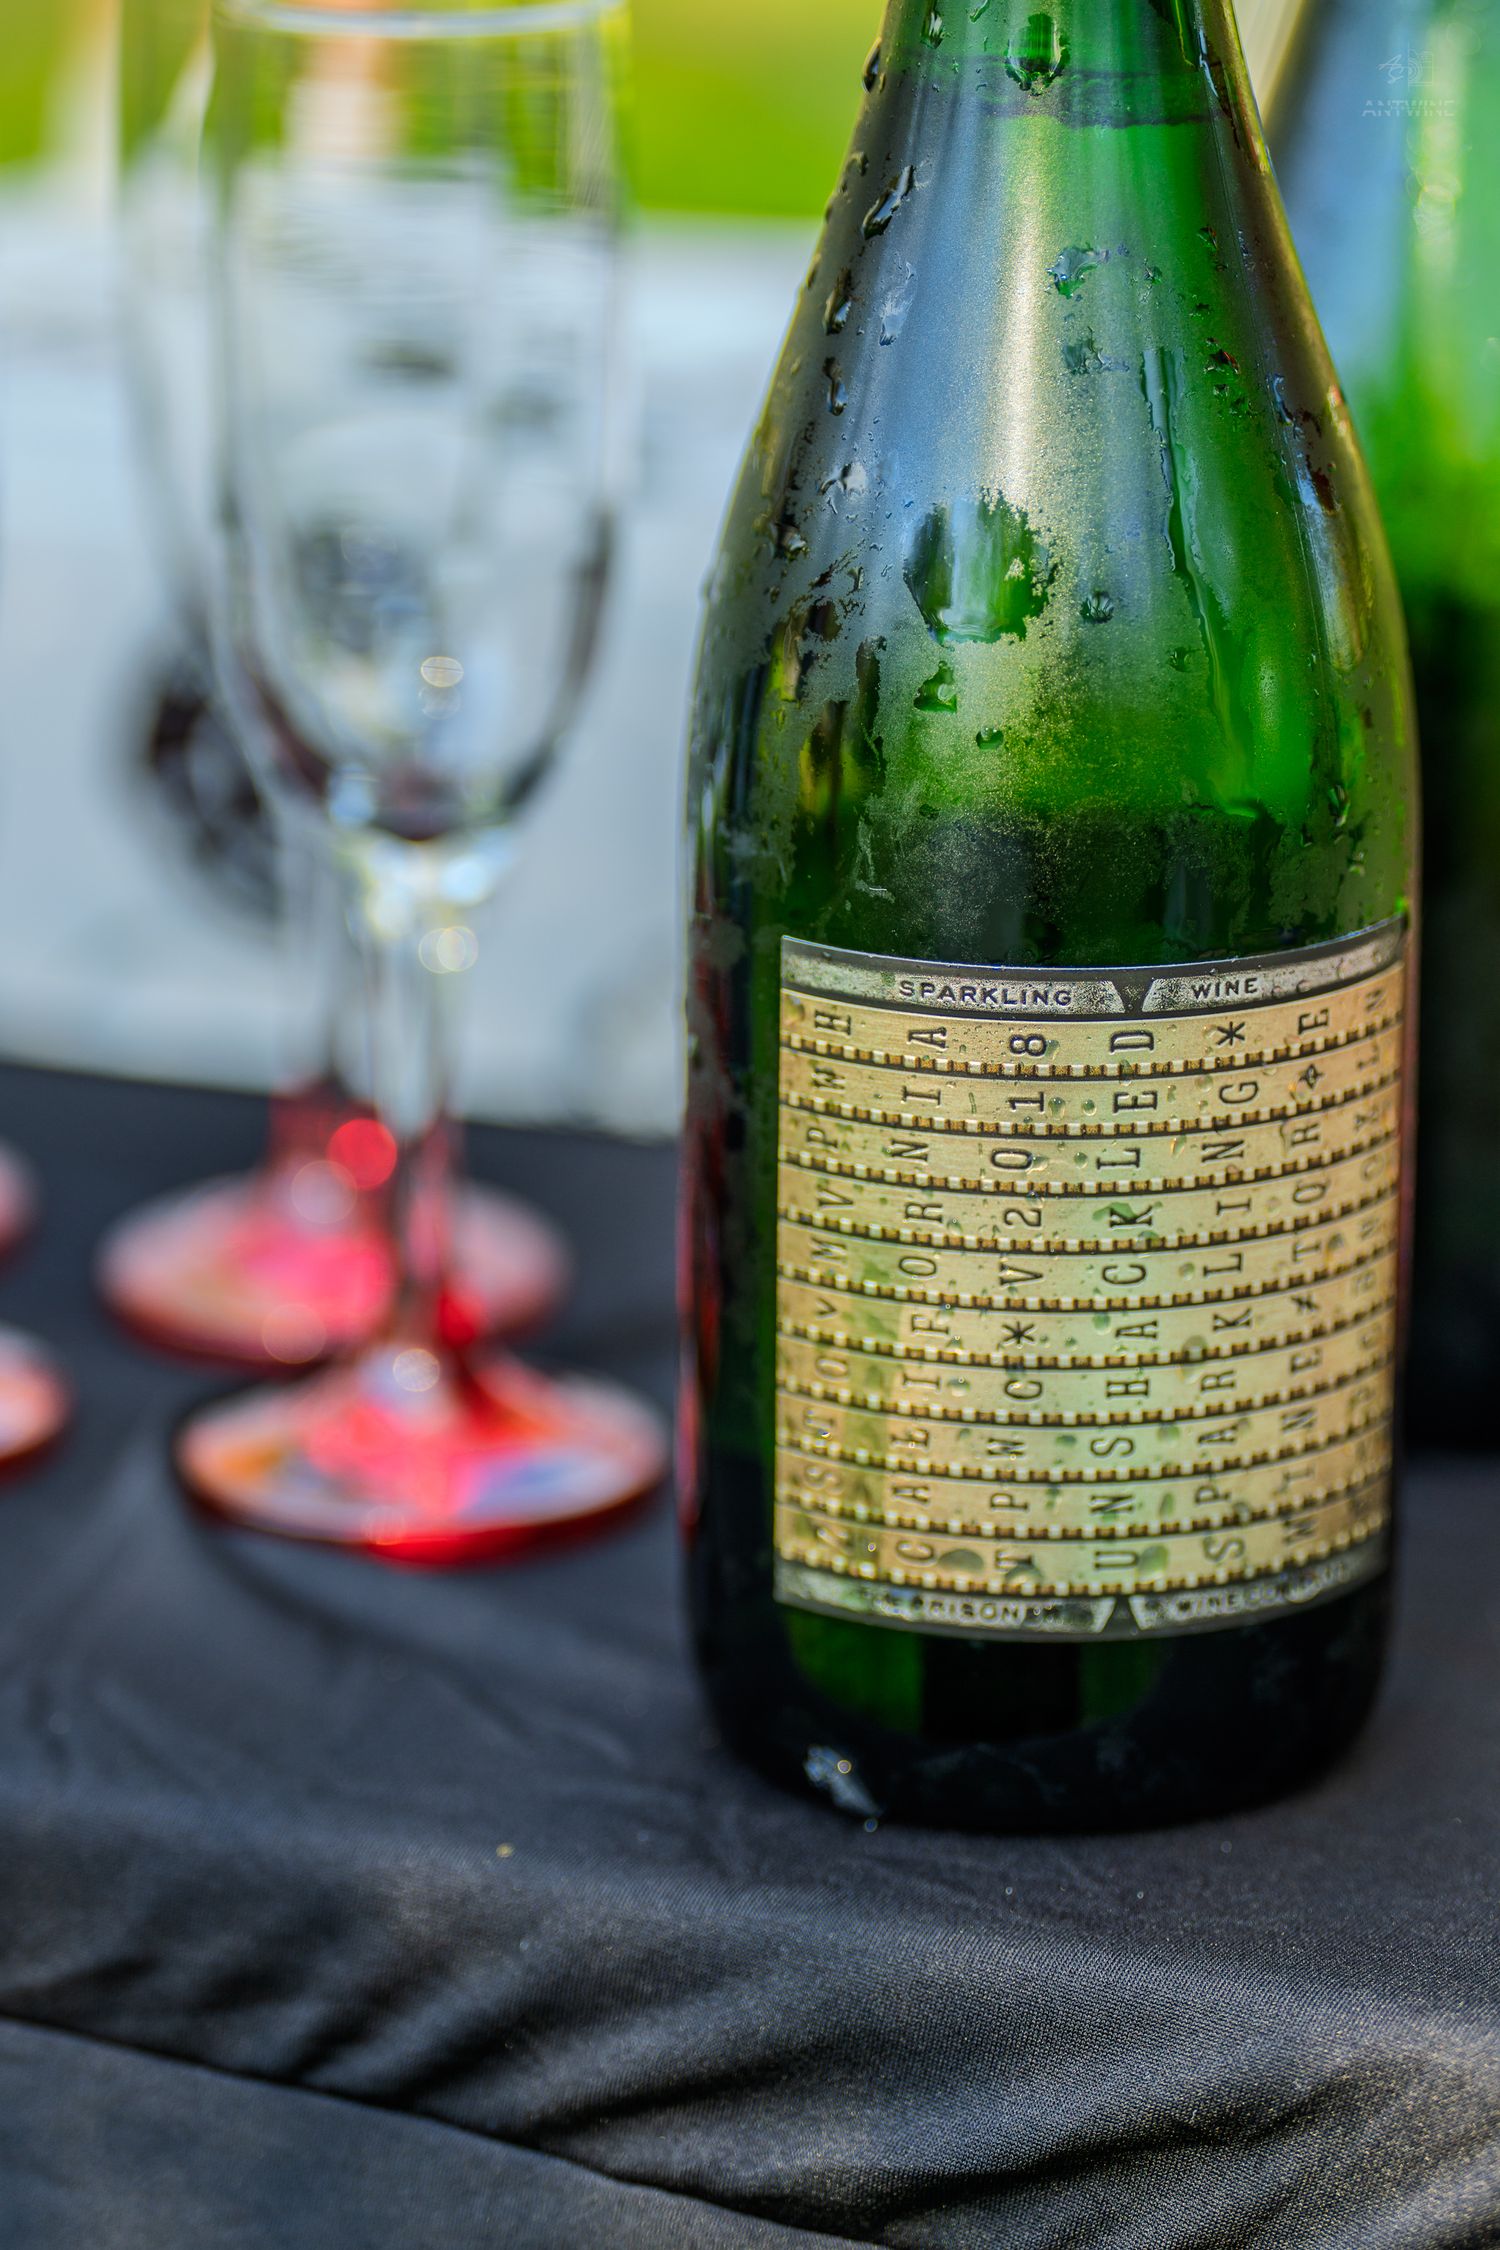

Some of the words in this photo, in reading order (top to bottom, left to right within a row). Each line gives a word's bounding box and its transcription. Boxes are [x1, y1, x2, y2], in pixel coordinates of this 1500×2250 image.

[898, 979, 1073, 1008] SPARKLING
[1191, 978, 1258, 998] WINE
[890, 1025, 950, 1567] CALIFORNIA
[1091, 1029, 1159, 1572] UNSHACKLED
